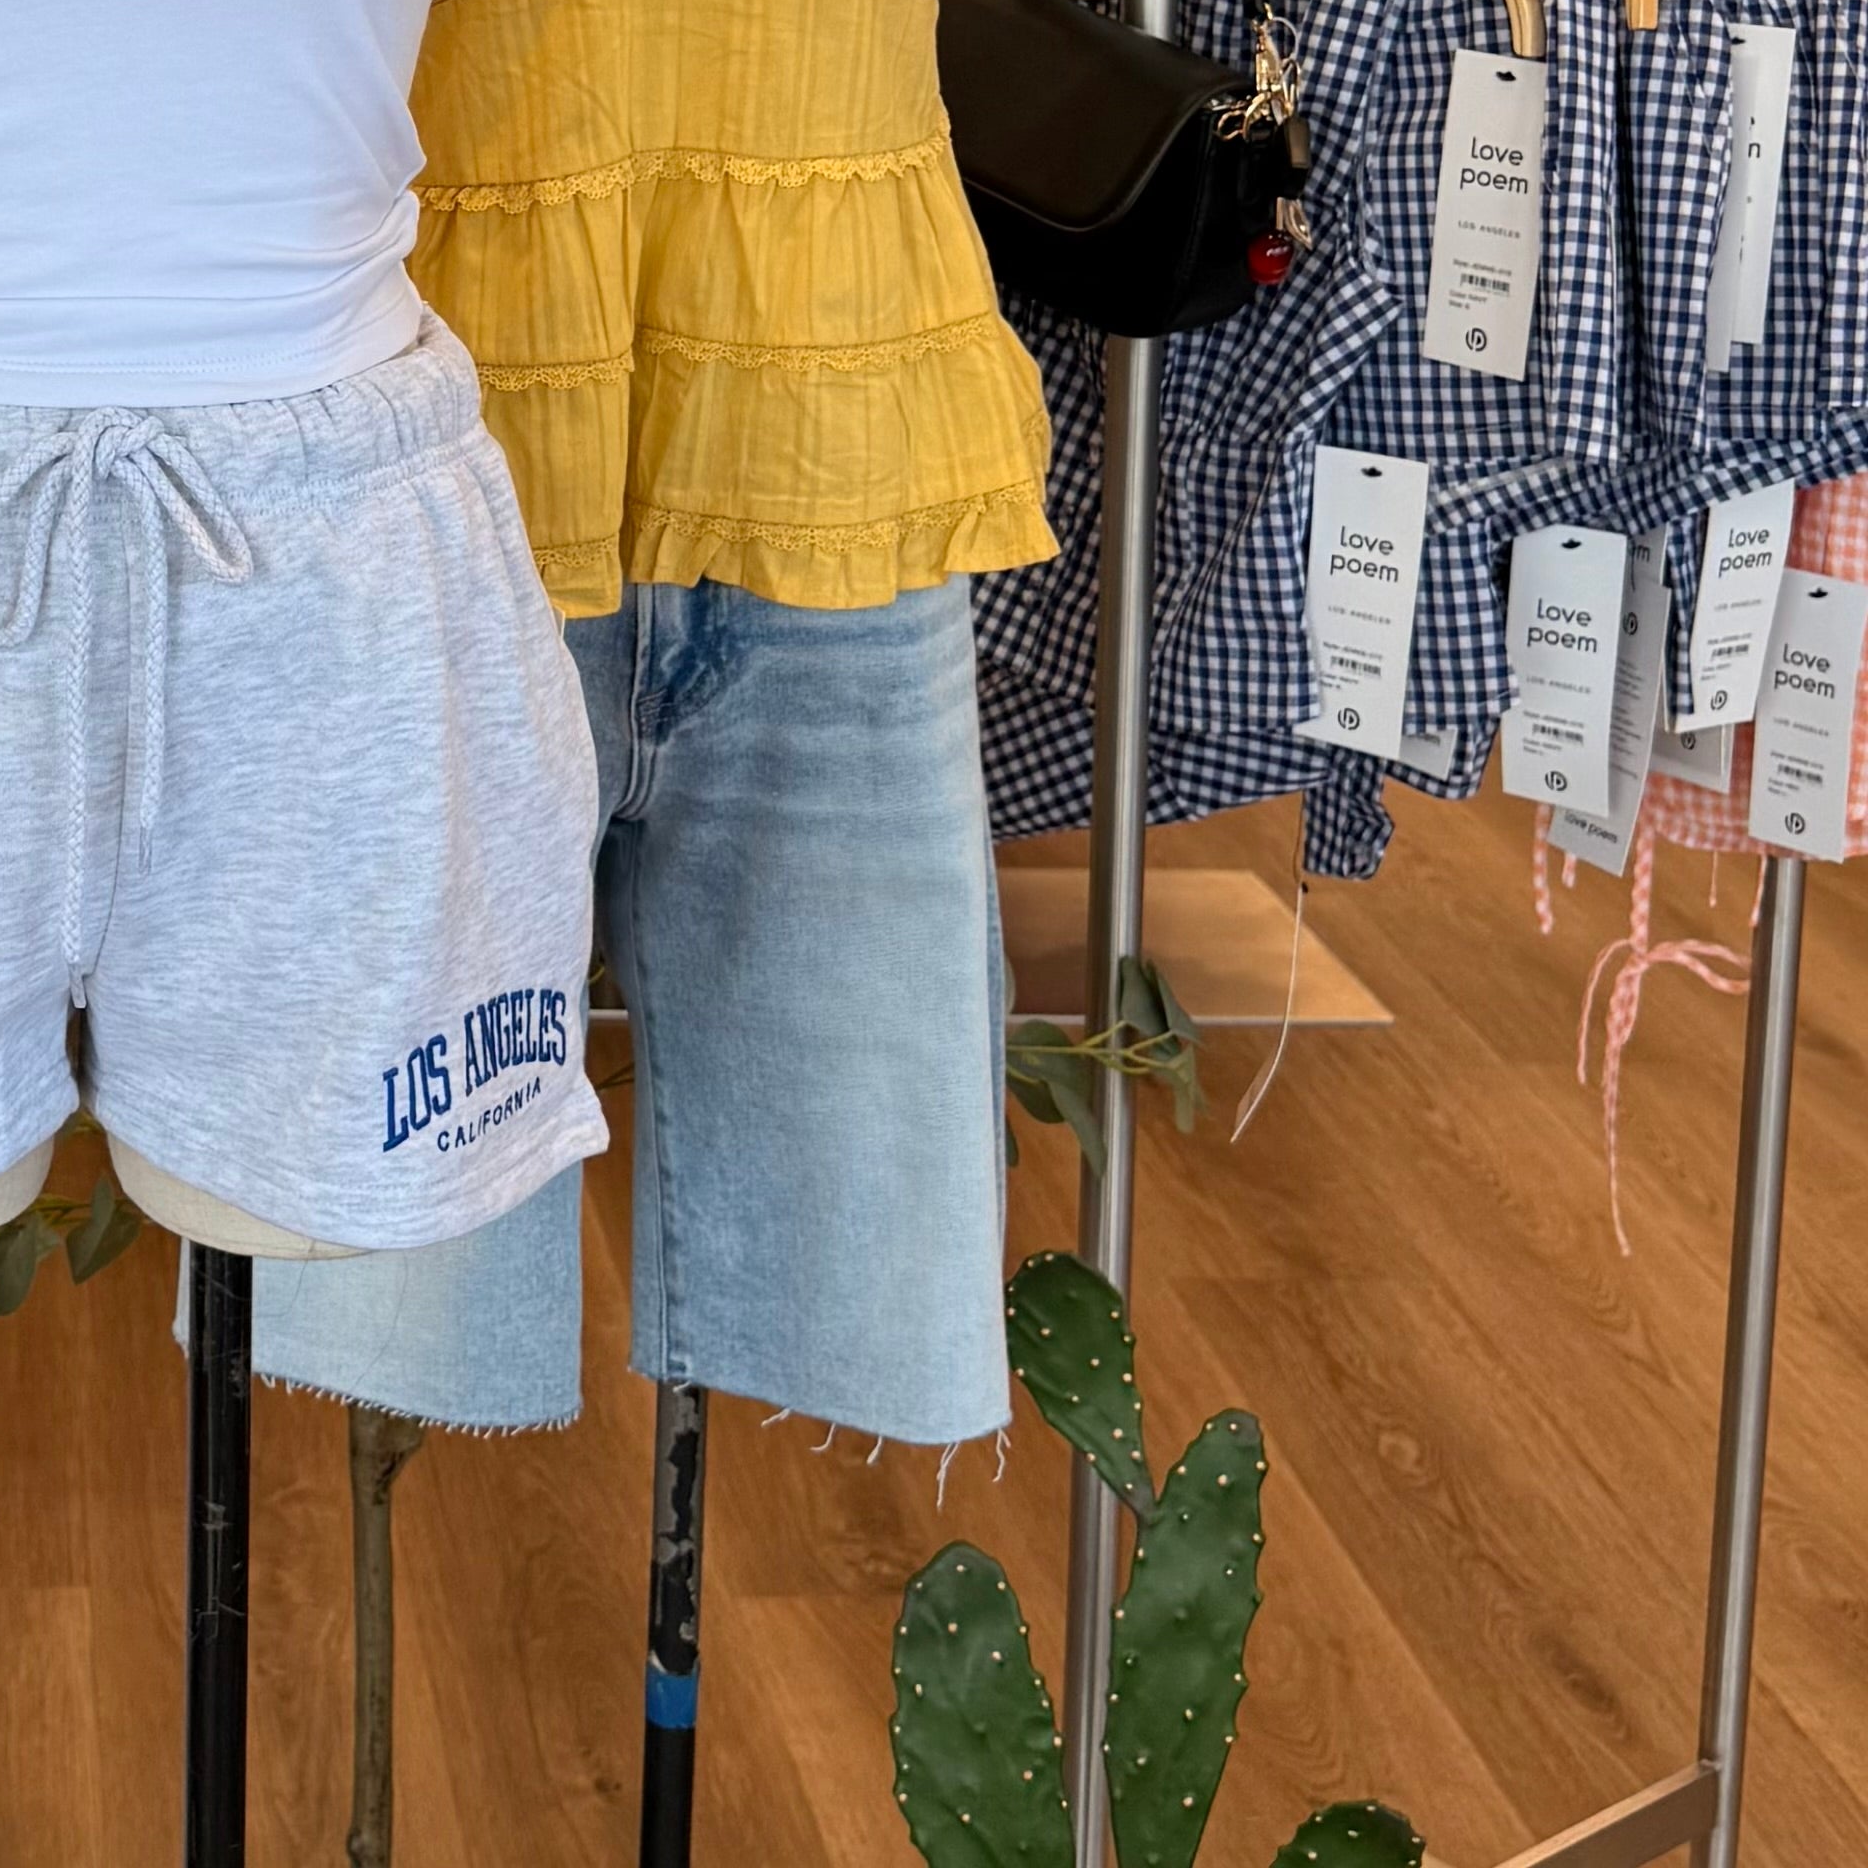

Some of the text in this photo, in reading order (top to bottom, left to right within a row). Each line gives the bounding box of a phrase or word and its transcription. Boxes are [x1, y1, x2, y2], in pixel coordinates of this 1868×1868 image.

[1471, 136, 1524, 166] love
[1460, 167, 1528, 195] poem
[1339, 525, 1394, 556] love
[1728, 528, 1770, 549] love
[1330, 553, 1399, 583] poem
[1718, 551, 1773, 578] poem
[1536, 597, 1592, 627] love
[1526, 627, 1598, 653] poem
[1782, 643, 1831, 673] love
[1773, 670, 1836, 699] poem
[382, 988, 567, 1153] LOS ANGELES
[437, 1076, 542, 1153] CALIFORNIA
